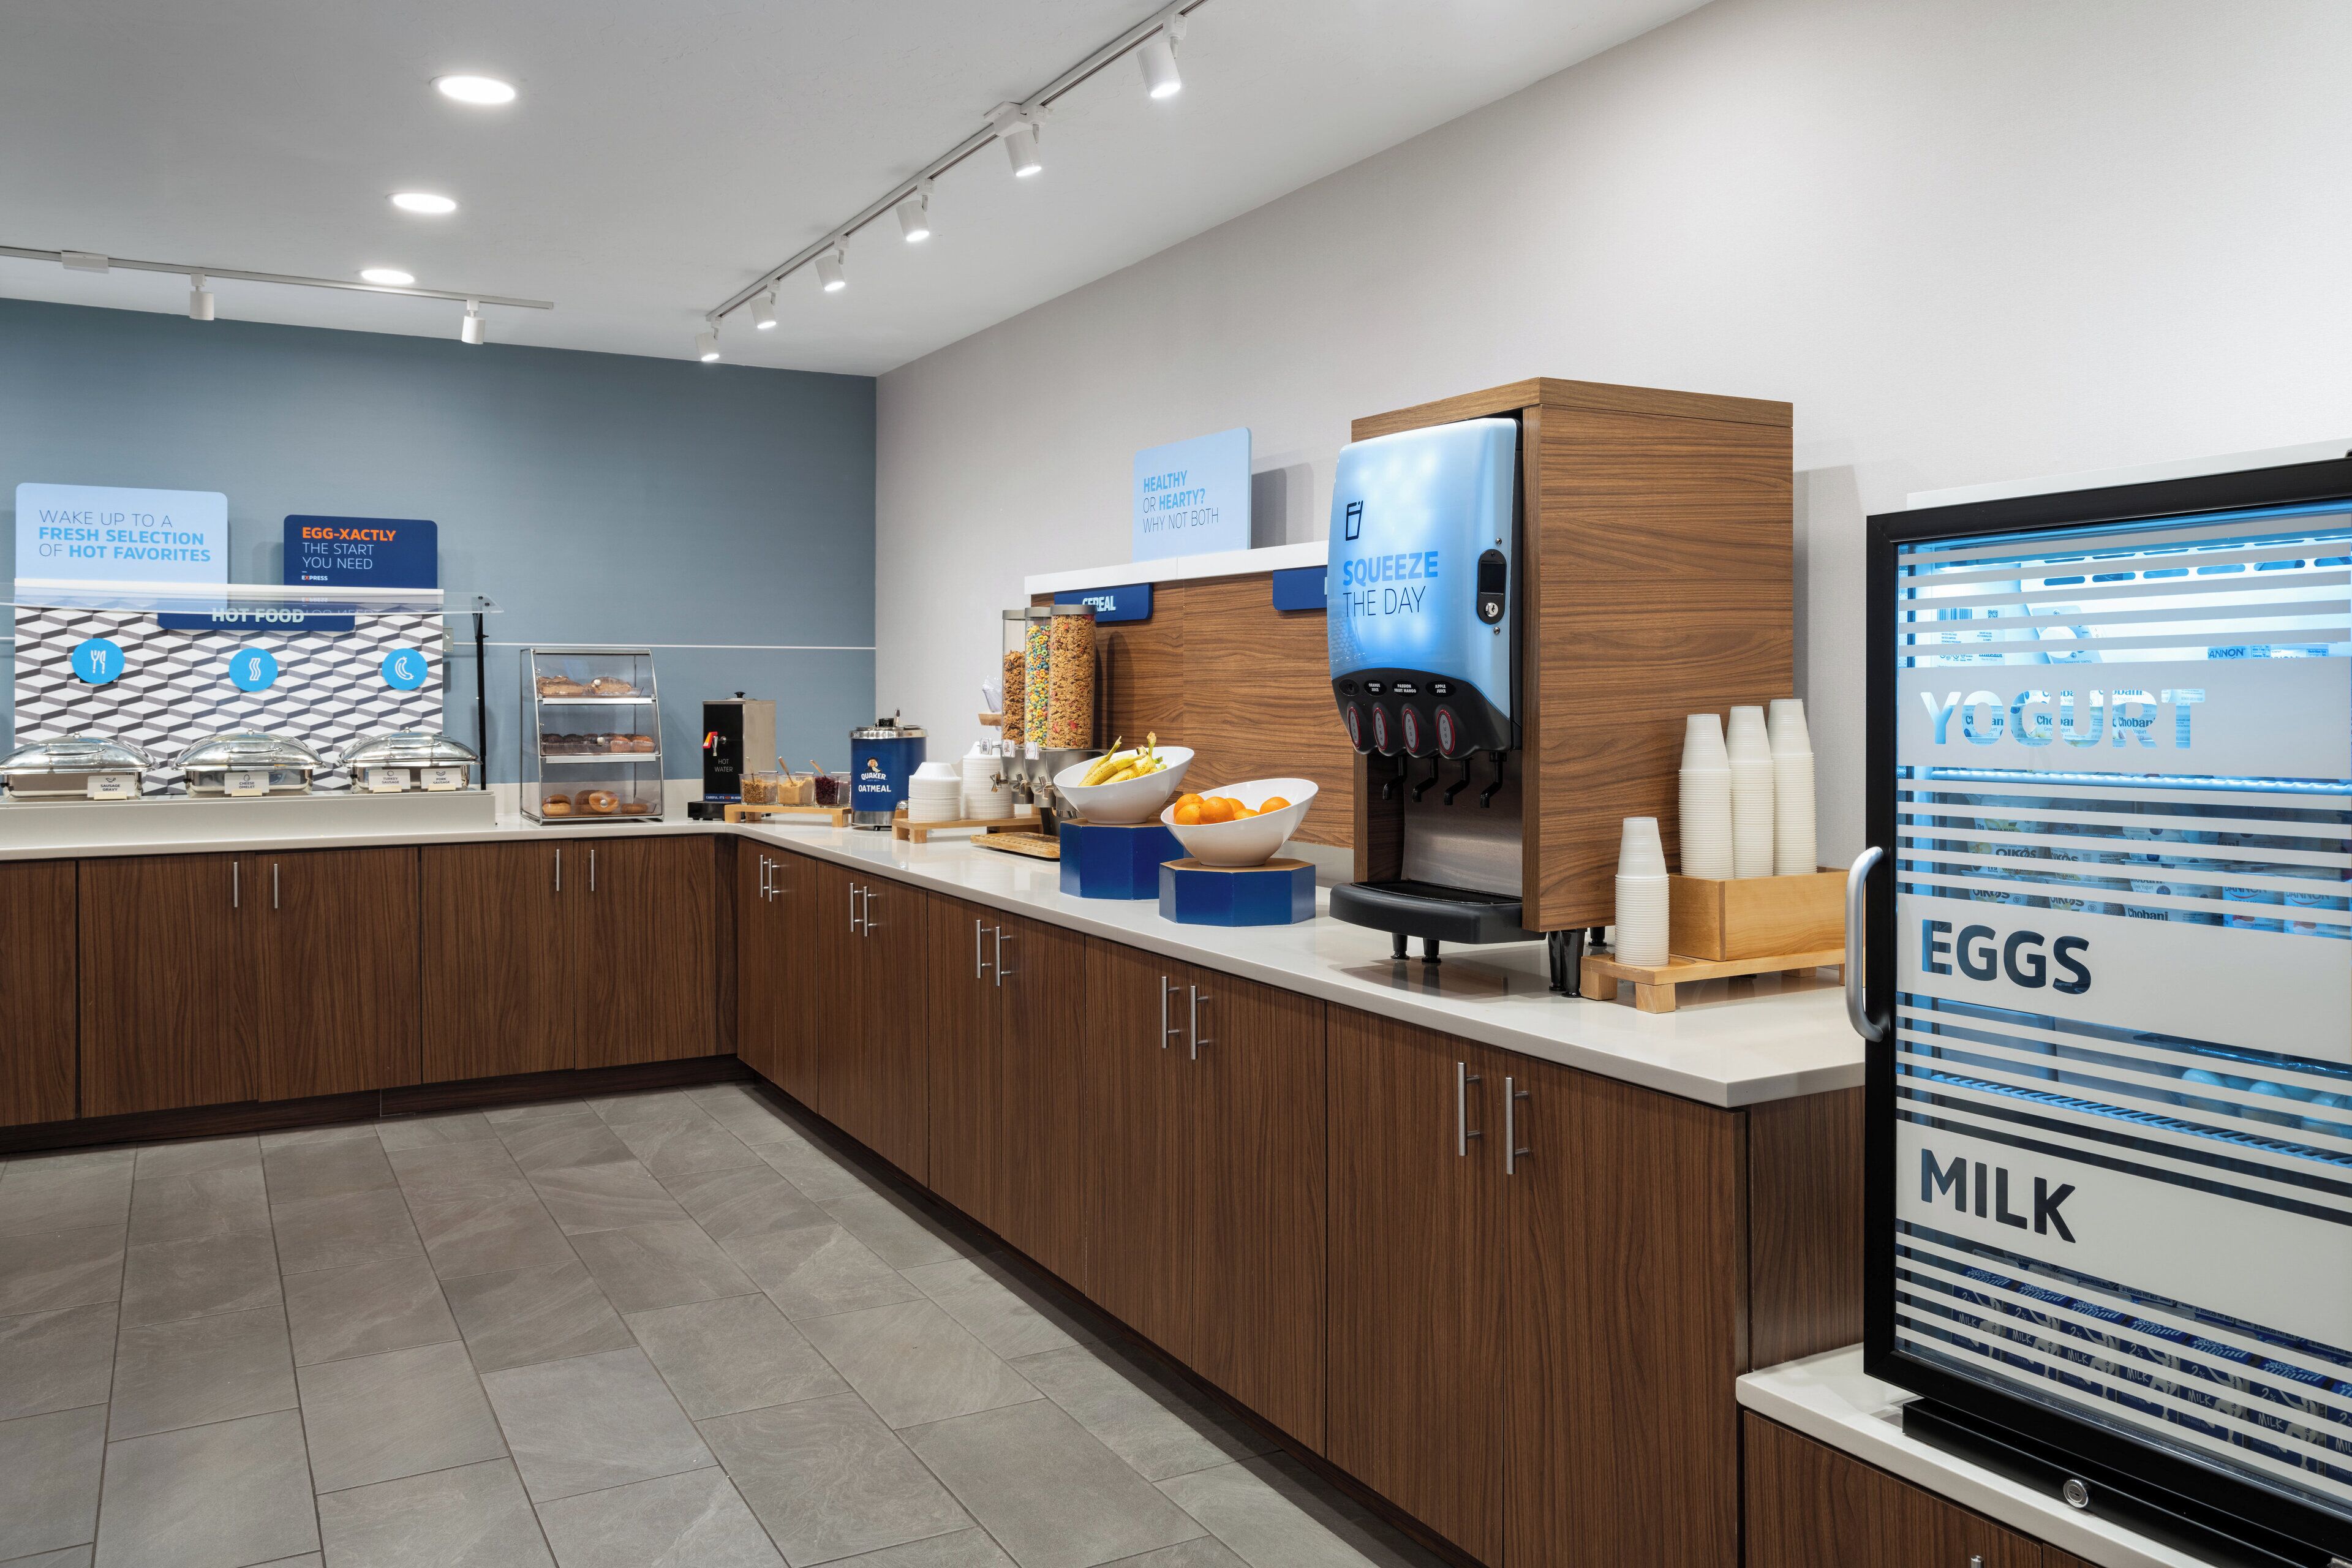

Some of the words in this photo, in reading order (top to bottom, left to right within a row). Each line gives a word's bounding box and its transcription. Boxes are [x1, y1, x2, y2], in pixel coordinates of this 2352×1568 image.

[1144, 470, 1188, 493] HEALTHY
[1143, 497, 1156, 513] OR
[1159, 488, 1205, 510] HEARTY?
[39, 510, 92, 525] WAKE
[100, 513, 124, 526] UP
[132, 513, 154, 527] TO
[161, 515, 173, 527] A
[1143, 515, 1165, 533] WHY
[1169, 511, 1188, 529] NOT
[1191, 507, 1218, 526] BOTH
[39, 527, 99, 541] FRESH
[106, 529, 204, 545] SELECTION
[302, 527, 396, 541] EGG-XACTLY
[39, 543, 62, 557] OF
[69, 545, 107, 558] HOT
[114, 546, 211, 562] FAVORITES
[302, 542, 328, 554] THE
[333, 543, 374, 556] START
[303, 557, 331, 568] YOU
[337, 558, 373, 570] NEED
[1343, 551, 1438, 587] SQUEEZE
[1343, 590, 1376, 617] THE
[1385, 586, 1426, 614] DAY
[211, 608, 249, 622] HOT
[255, 608, 305, 623] FOOD
[2208, 648, 2244, 659] ANNON
[1920, 688, 2205, 749] YOGURT
[2119, 717, 2155, 728] Choban
[2128, 908, 2168, 921] Chobani
[1922, 919, 2092, 994] EGGS
[1921, 1148, 2076, 1243] MILK
[1959, 1313, 1978, 1328] MILK
[2012, 1330, 2032, 1344] MILK
[2067, 1349, 2089, 1364] MILK
[2127, 1368, 2149, 1382] MILK
[2188, 1390, 2212, 1406] MILK
[2258, 1412, 2283, 1430] MILK
[2335, 1438, 2352, 1453] MIL
